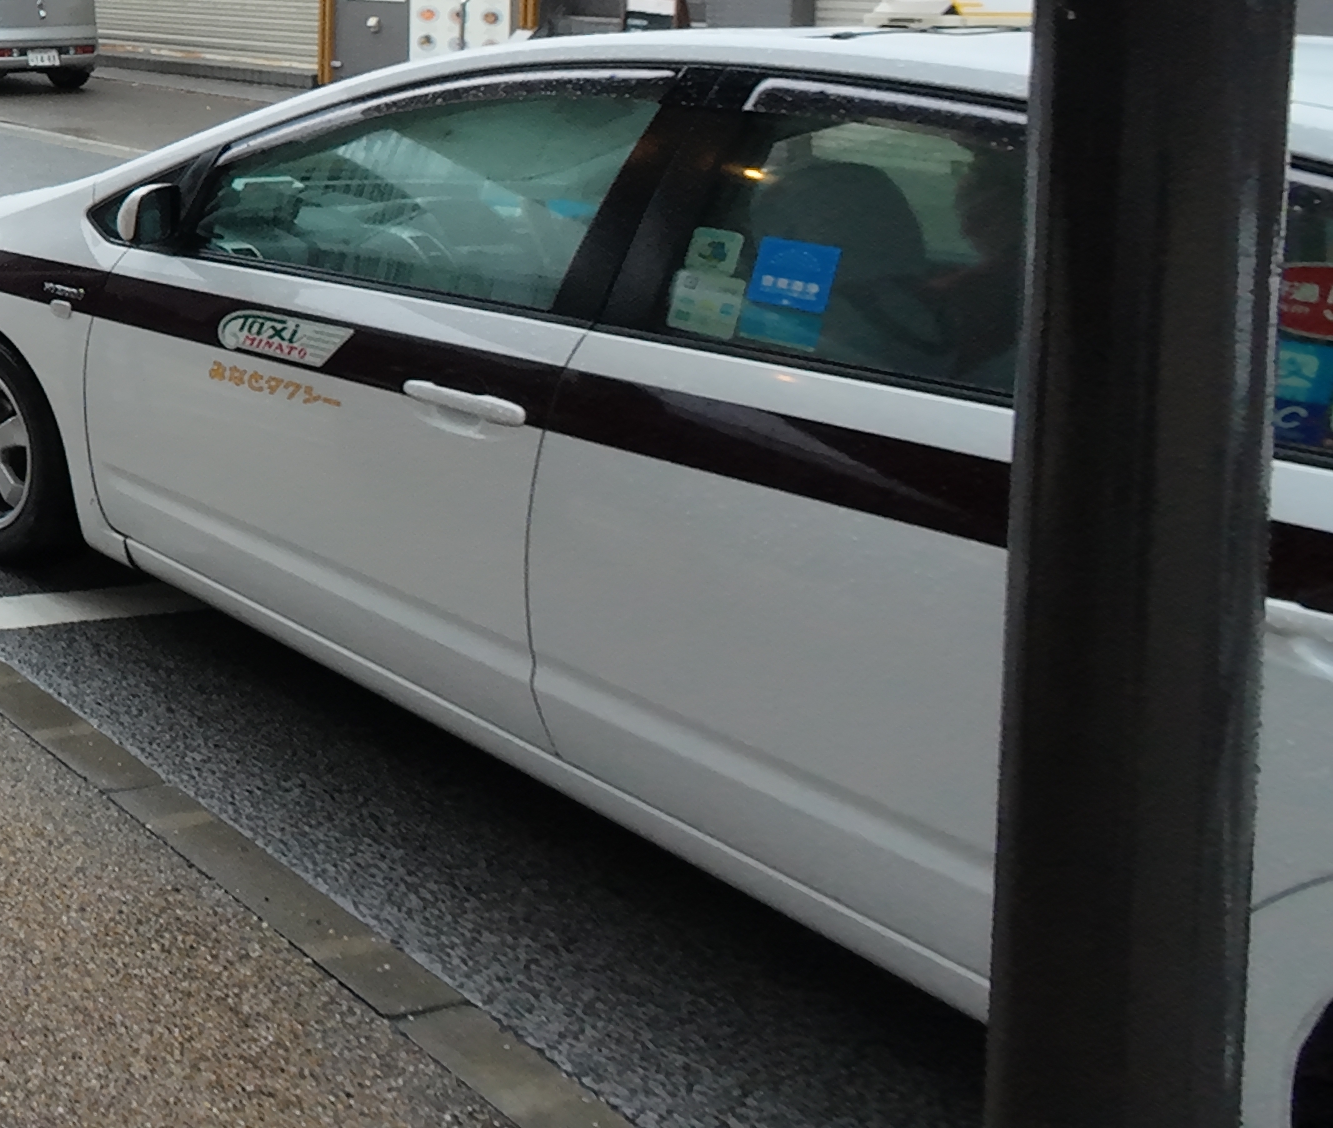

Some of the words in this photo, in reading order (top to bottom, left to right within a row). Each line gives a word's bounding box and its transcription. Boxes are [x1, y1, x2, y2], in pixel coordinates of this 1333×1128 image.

[223, 313, 303, 344] Taxi
[242, 335, 308, 360] MINATO
[208, 359, 342, 407] みなとタクシー
